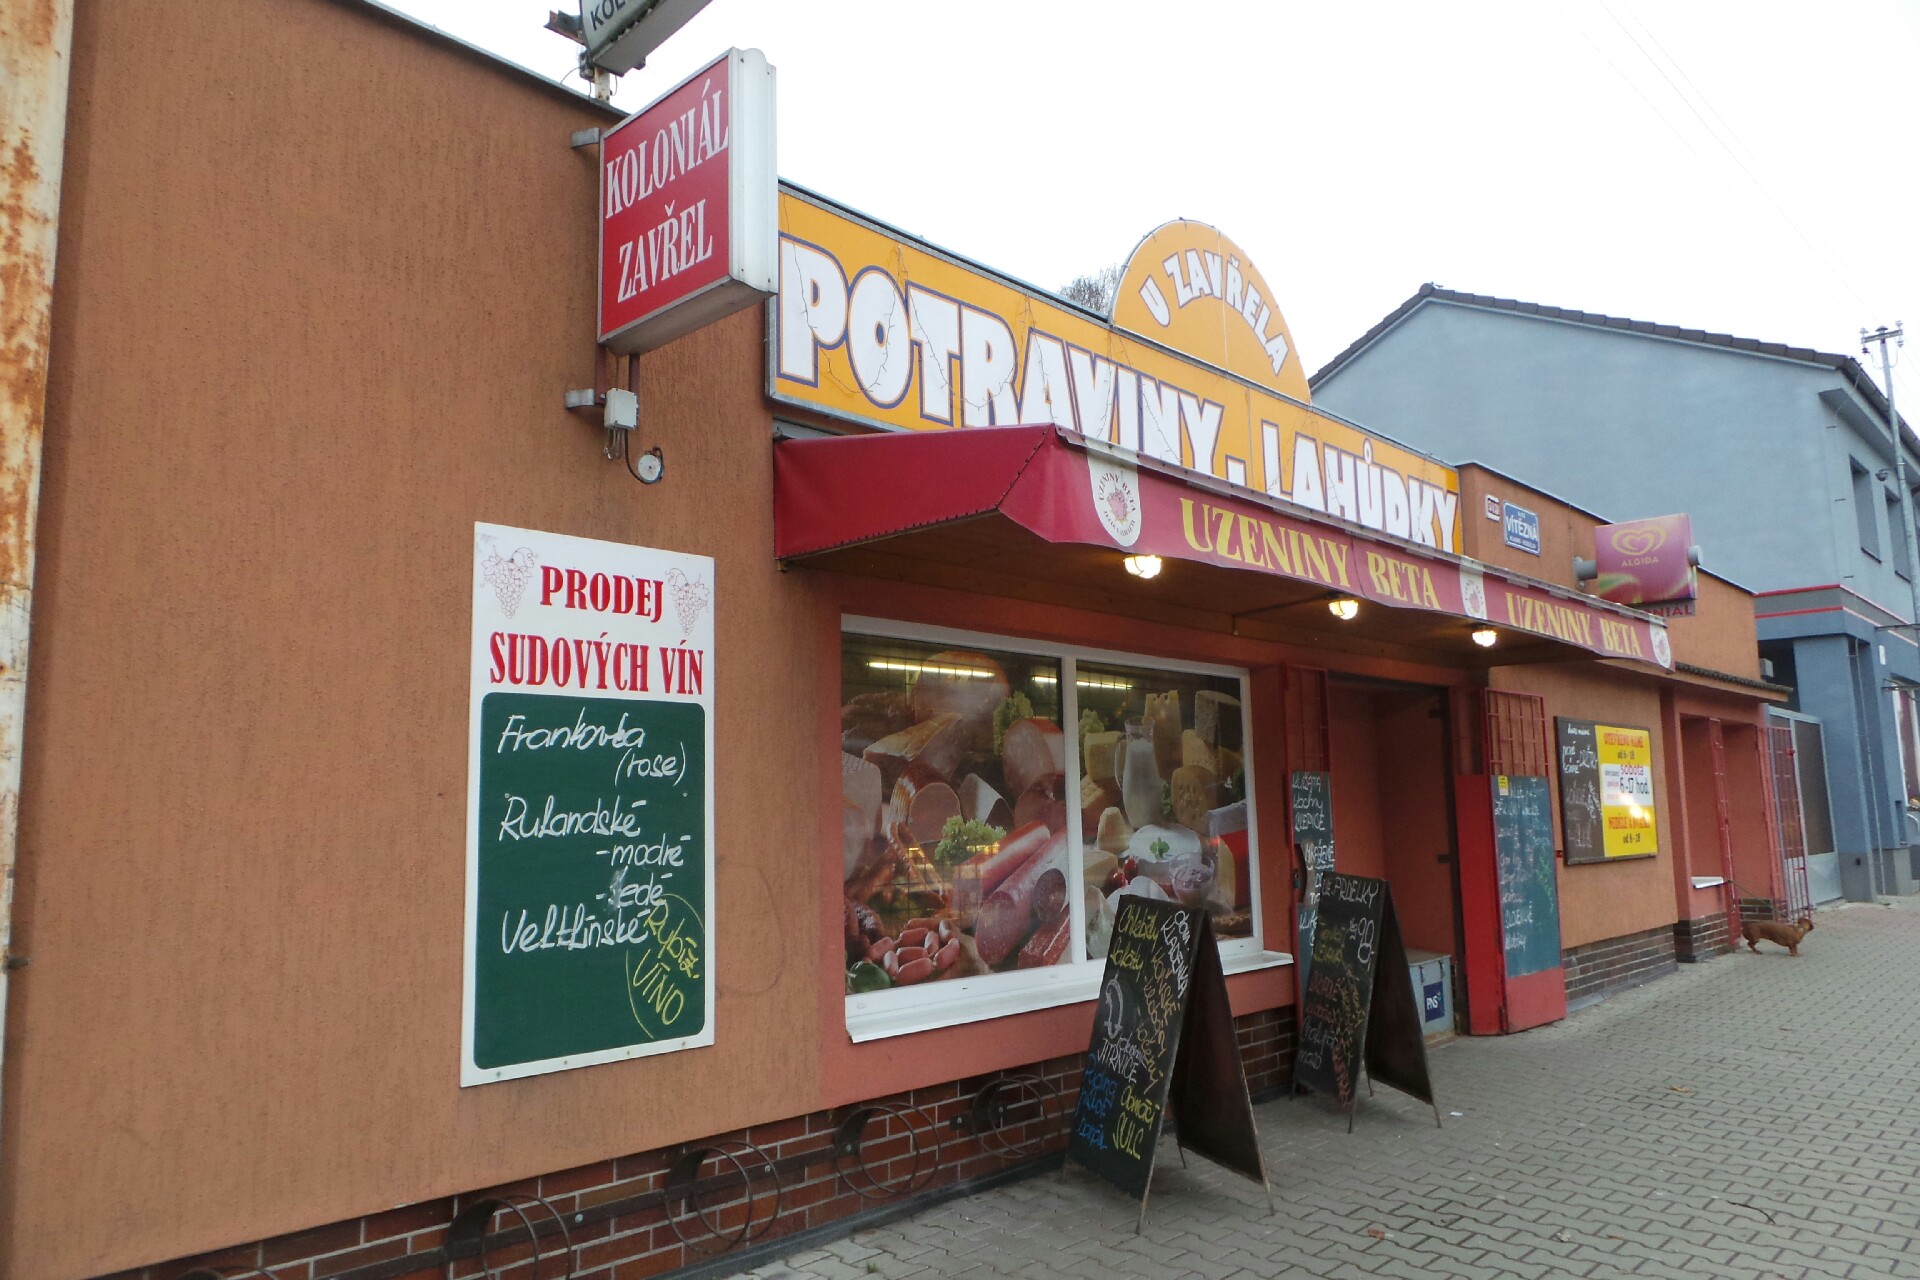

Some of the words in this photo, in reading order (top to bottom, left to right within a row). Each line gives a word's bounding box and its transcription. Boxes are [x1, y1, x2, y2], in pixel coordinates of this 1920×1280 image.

[606, 79, 729, 219] KOLONIÁL
[618, 199, 712, 303] ZAVŘEL
[1138, 276, 1171, 327] U
[1163, 249, 1290, 376] ZAVŘELA
[1261, 419, 1459, 553] LAHŮDKY
[1180, 497, 1355, 588] UZENINY
[1366, 550, 1442, 609] BETA
[1506, 514, 1539, 542] VÍTĚZNÁ
[540, 565, 663, 623] PRODEJ
[1622, 556, 1659, 567] ALGIDA
[1506, 592, 1593, 646] UZENINY
[1600, 618, 1643, 657] BETA
[489, 631, 649, 692] SUDOVÝCH
[659, 639, 704, 695] VÍN
[499, 795, 647, 841] Rulandské
